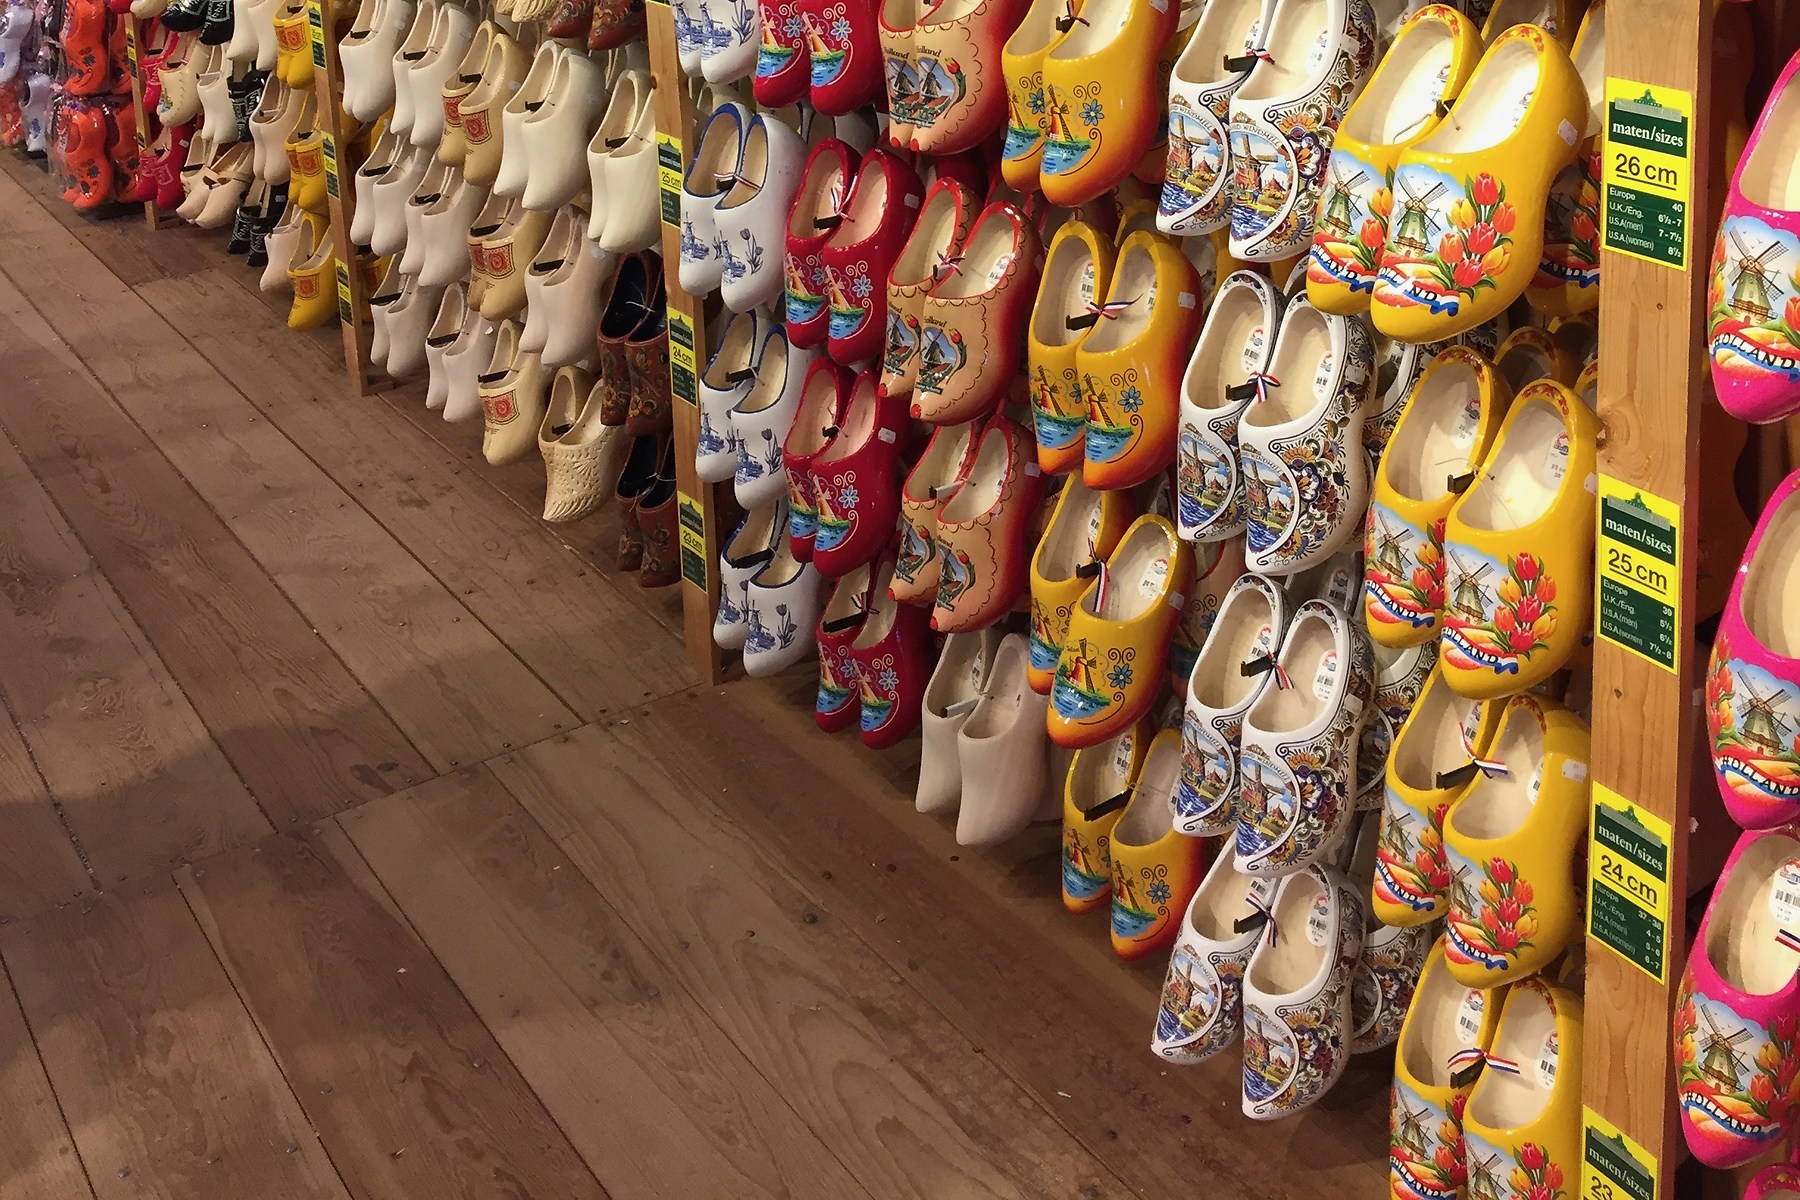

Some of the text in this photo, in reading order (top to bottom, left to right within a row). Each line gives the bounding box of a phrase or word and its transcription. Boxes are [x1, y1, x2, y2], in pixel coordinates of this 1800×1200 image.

[1179, 106, 1213, 130] WINDMILL
[1243, 124, 1279, 146] WINDMILL
[1612, 121, 1684, 147] maten/sizes
[1615, 153, 1677, 186] 26 cm
[1609, 187, 1683, 213] Europe 40
[1714, 332, 1796, 370] HOLLAND
[1605, 517, 1672, 556] maten/sizes
[1608, 548, 1667, 590] 25 cm
[1603, 579, 1673, 617] Europe 39
[1722, 754, 1800, 797] HOLLAND
[1598, 824, 1664, 872] maten/sizes
[1595, 882, 1619, 903] Europe
[1600, 854, 1658, 904] 24 cm
[1686, 1089, 1763, 1134] HOLLAND
[1589, 1146, 1650, 1200] maten/sizes
[1591, 1175, 1613, 1200] 23
